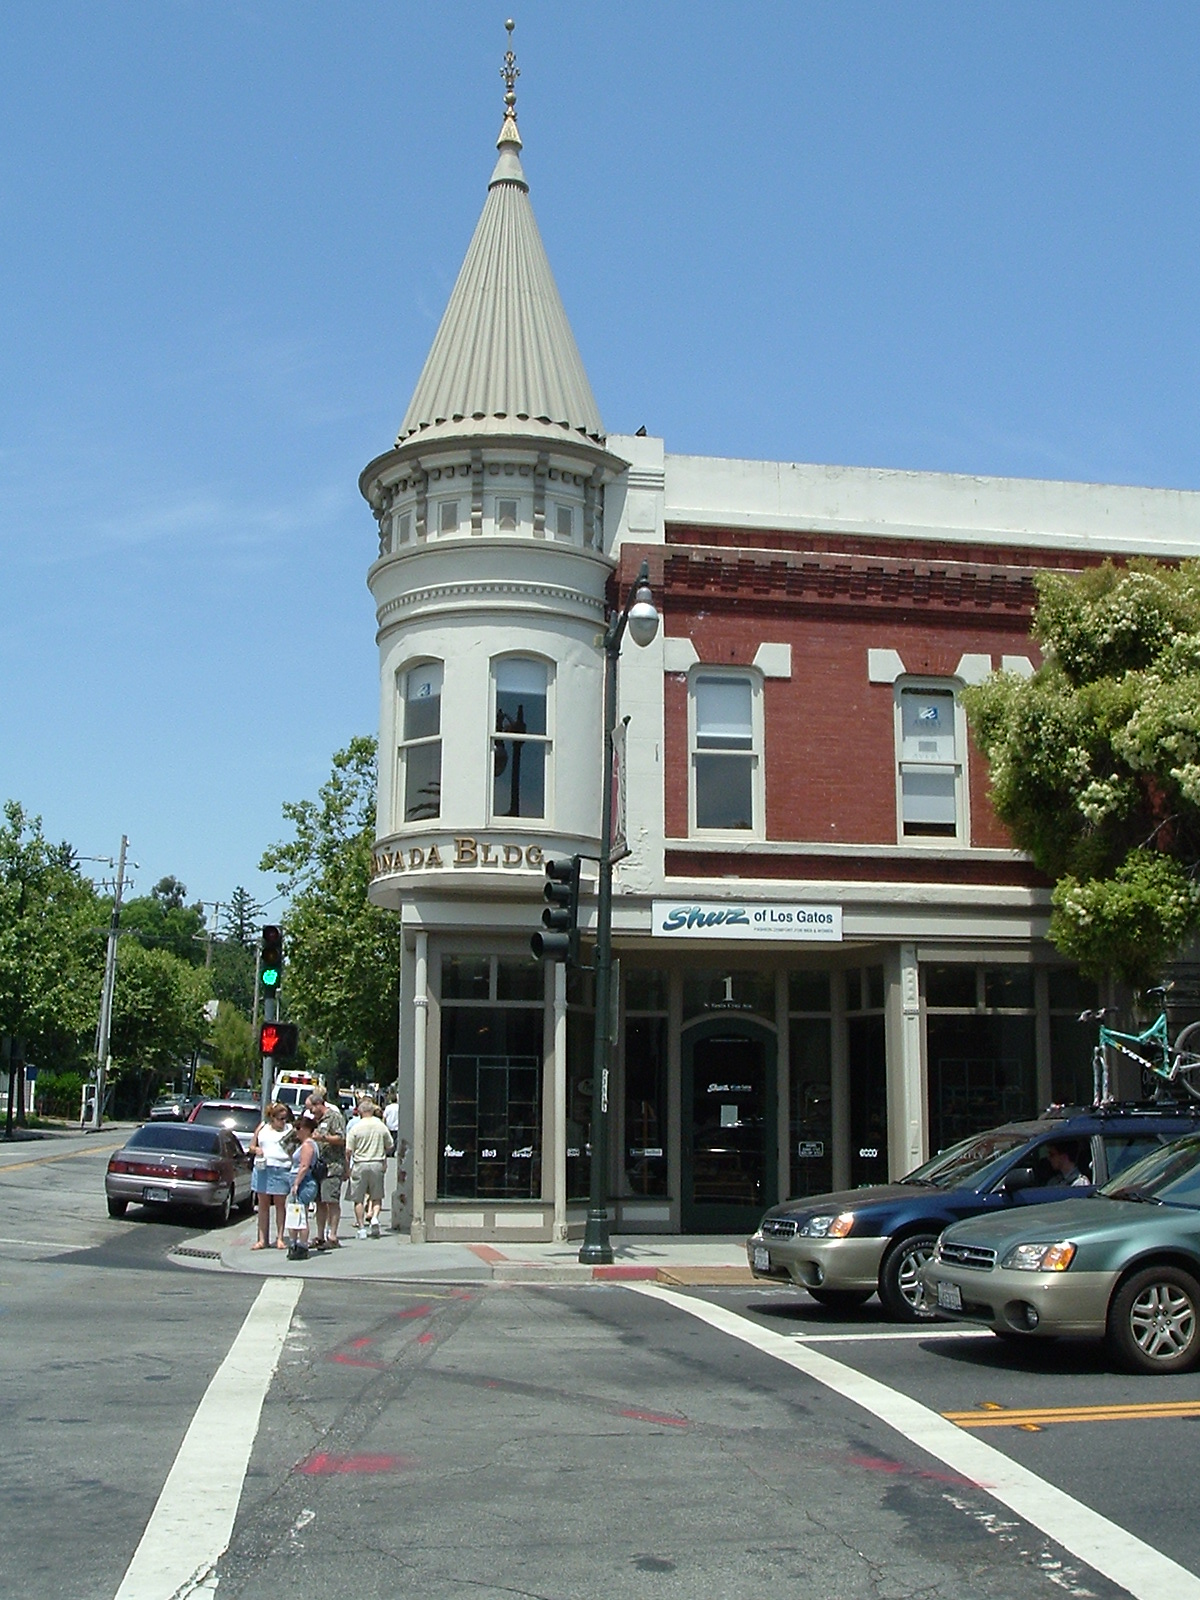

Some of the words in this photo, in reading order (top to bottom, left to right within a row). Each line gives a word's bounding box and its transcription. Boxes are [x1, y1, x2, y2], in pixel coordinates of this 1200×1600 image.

[662, 905, 750, 932] Shuz
[754, 909, 767, 923] of
[770, 909, 793, 924] Los
[796, 910, 833, 924] Gatos
[722, 976, 734, 1001] 1
